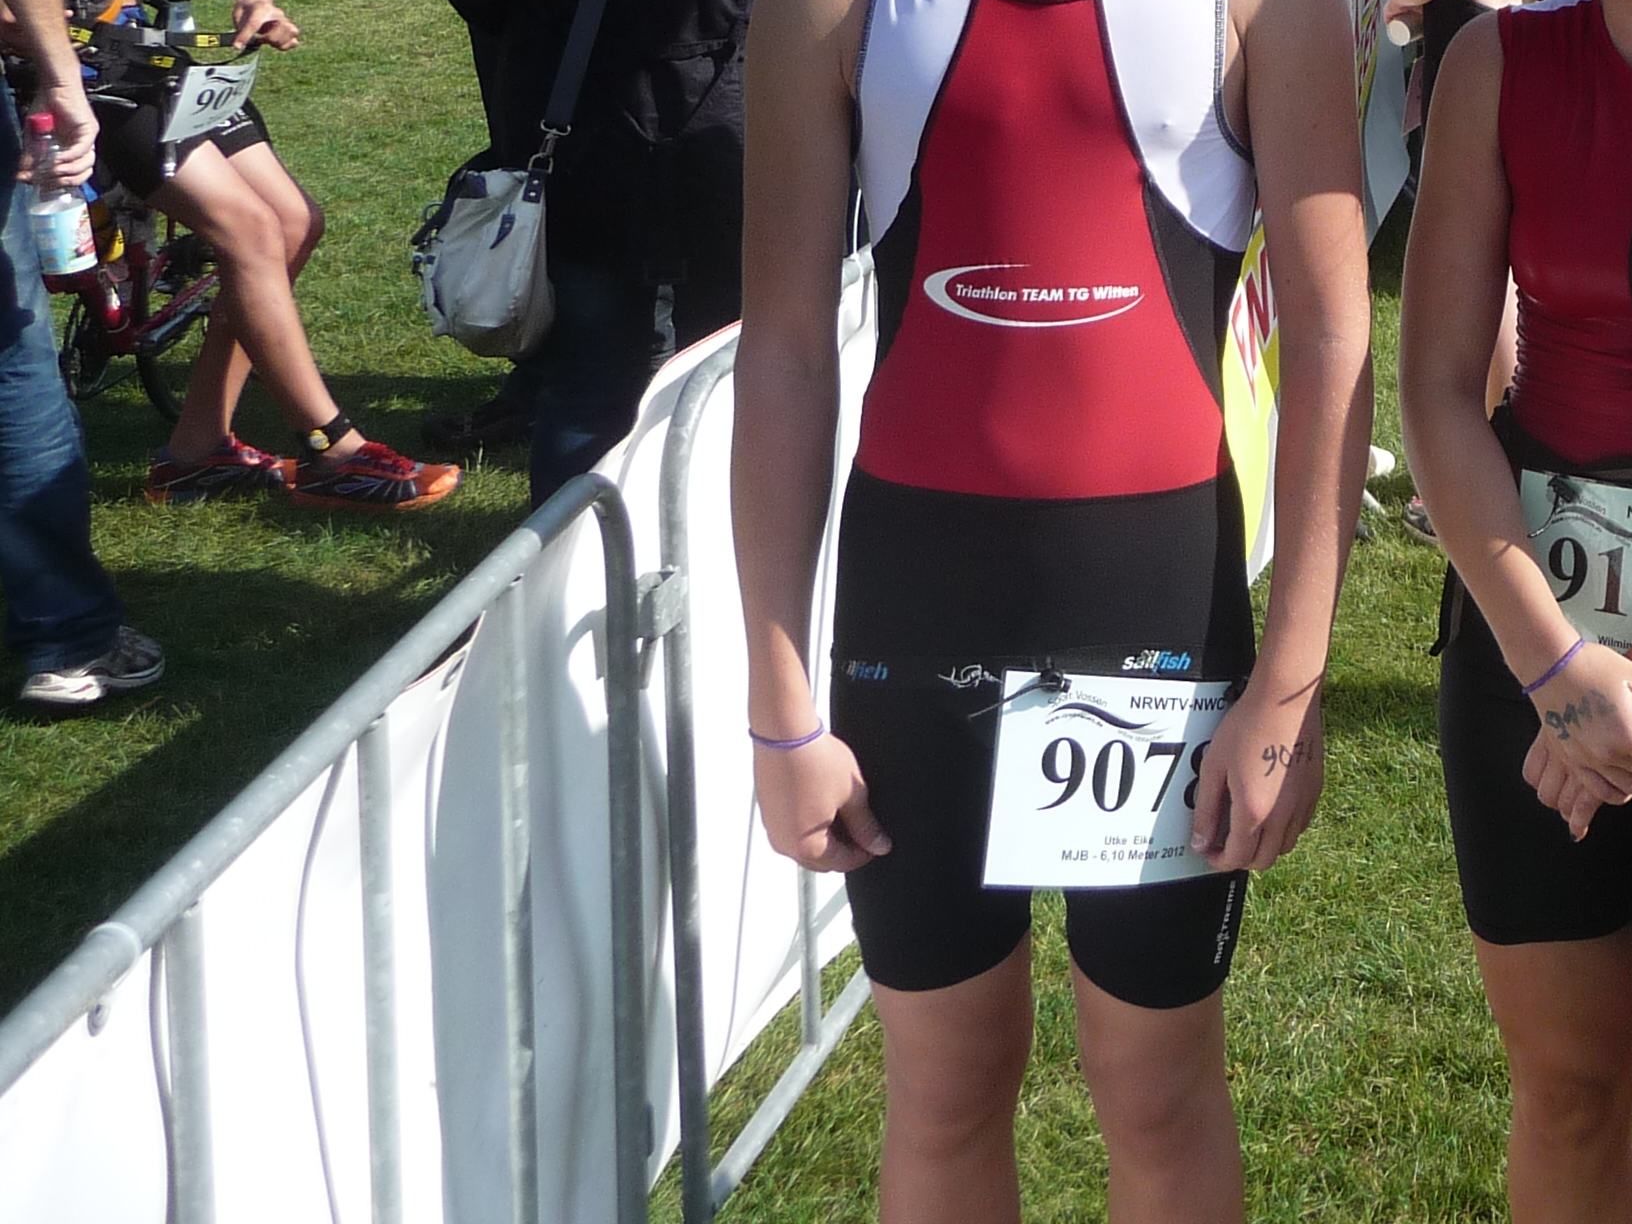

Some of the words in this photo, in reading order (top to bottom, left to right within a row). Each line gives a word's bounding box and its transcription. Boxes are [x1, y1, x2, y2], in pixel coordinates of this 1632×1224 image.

[190, 85, 242, 116] 90
[955, 284, 1017, 301] Triathlon
[1022, 287, 1064, 302] TEAM
[1068, 287, 1090, 301] TG
[1092, 284, 1139, 300] Witten
[1121, 649, 1191, 676] sailfish
[1075, 690, 1108, 707] Vossen
[1104, 835, 1128, 846] Utke
[1133, 835, 1154, 846] Eike
[1061, 849, 1089, 861] MJB
[1100, 850, 1125, 862] 6,10
[1128, 848, 1159, 861] Meter
[1161, 846, 1185, 859] 2012
